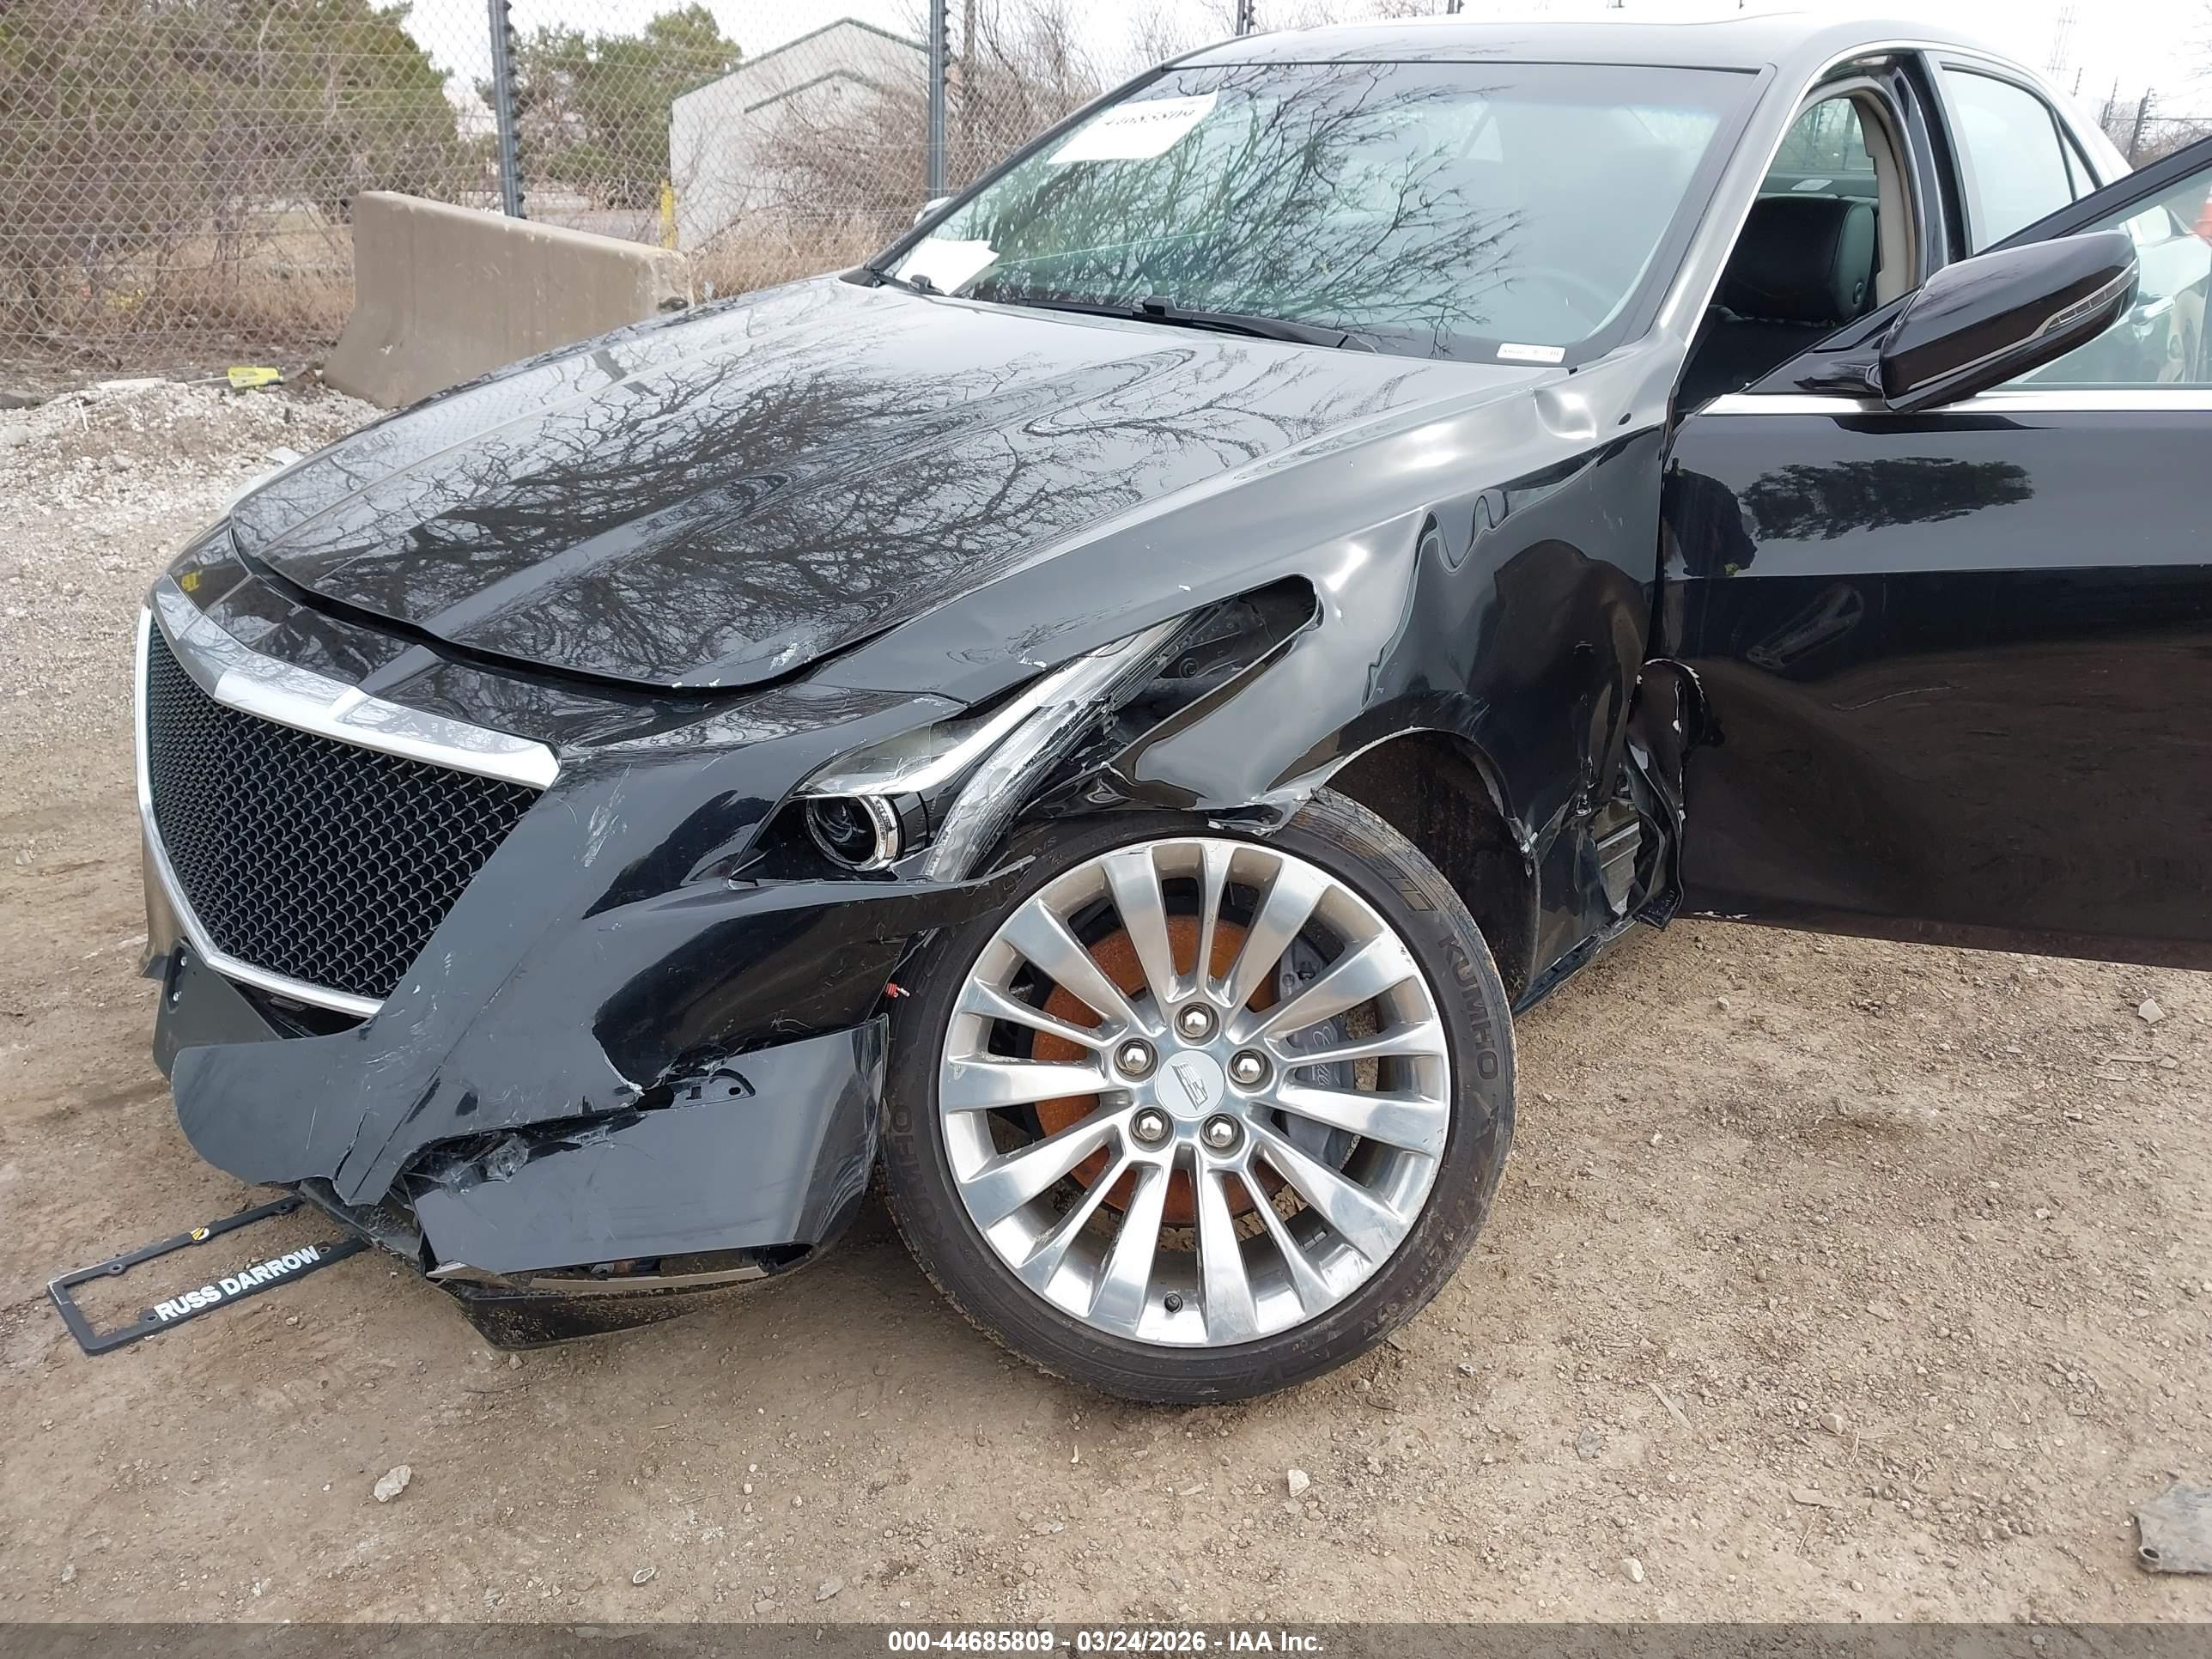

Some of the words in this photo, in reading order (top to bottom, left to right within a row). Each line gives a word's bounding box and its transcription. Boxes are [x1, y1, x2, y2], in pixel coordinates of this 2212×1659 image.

[1437, 933, 1499, 1081] KUMHO
[154, 1285, 222, 1322] RUSS
[219, 1245, 320, 1296] DARROW
